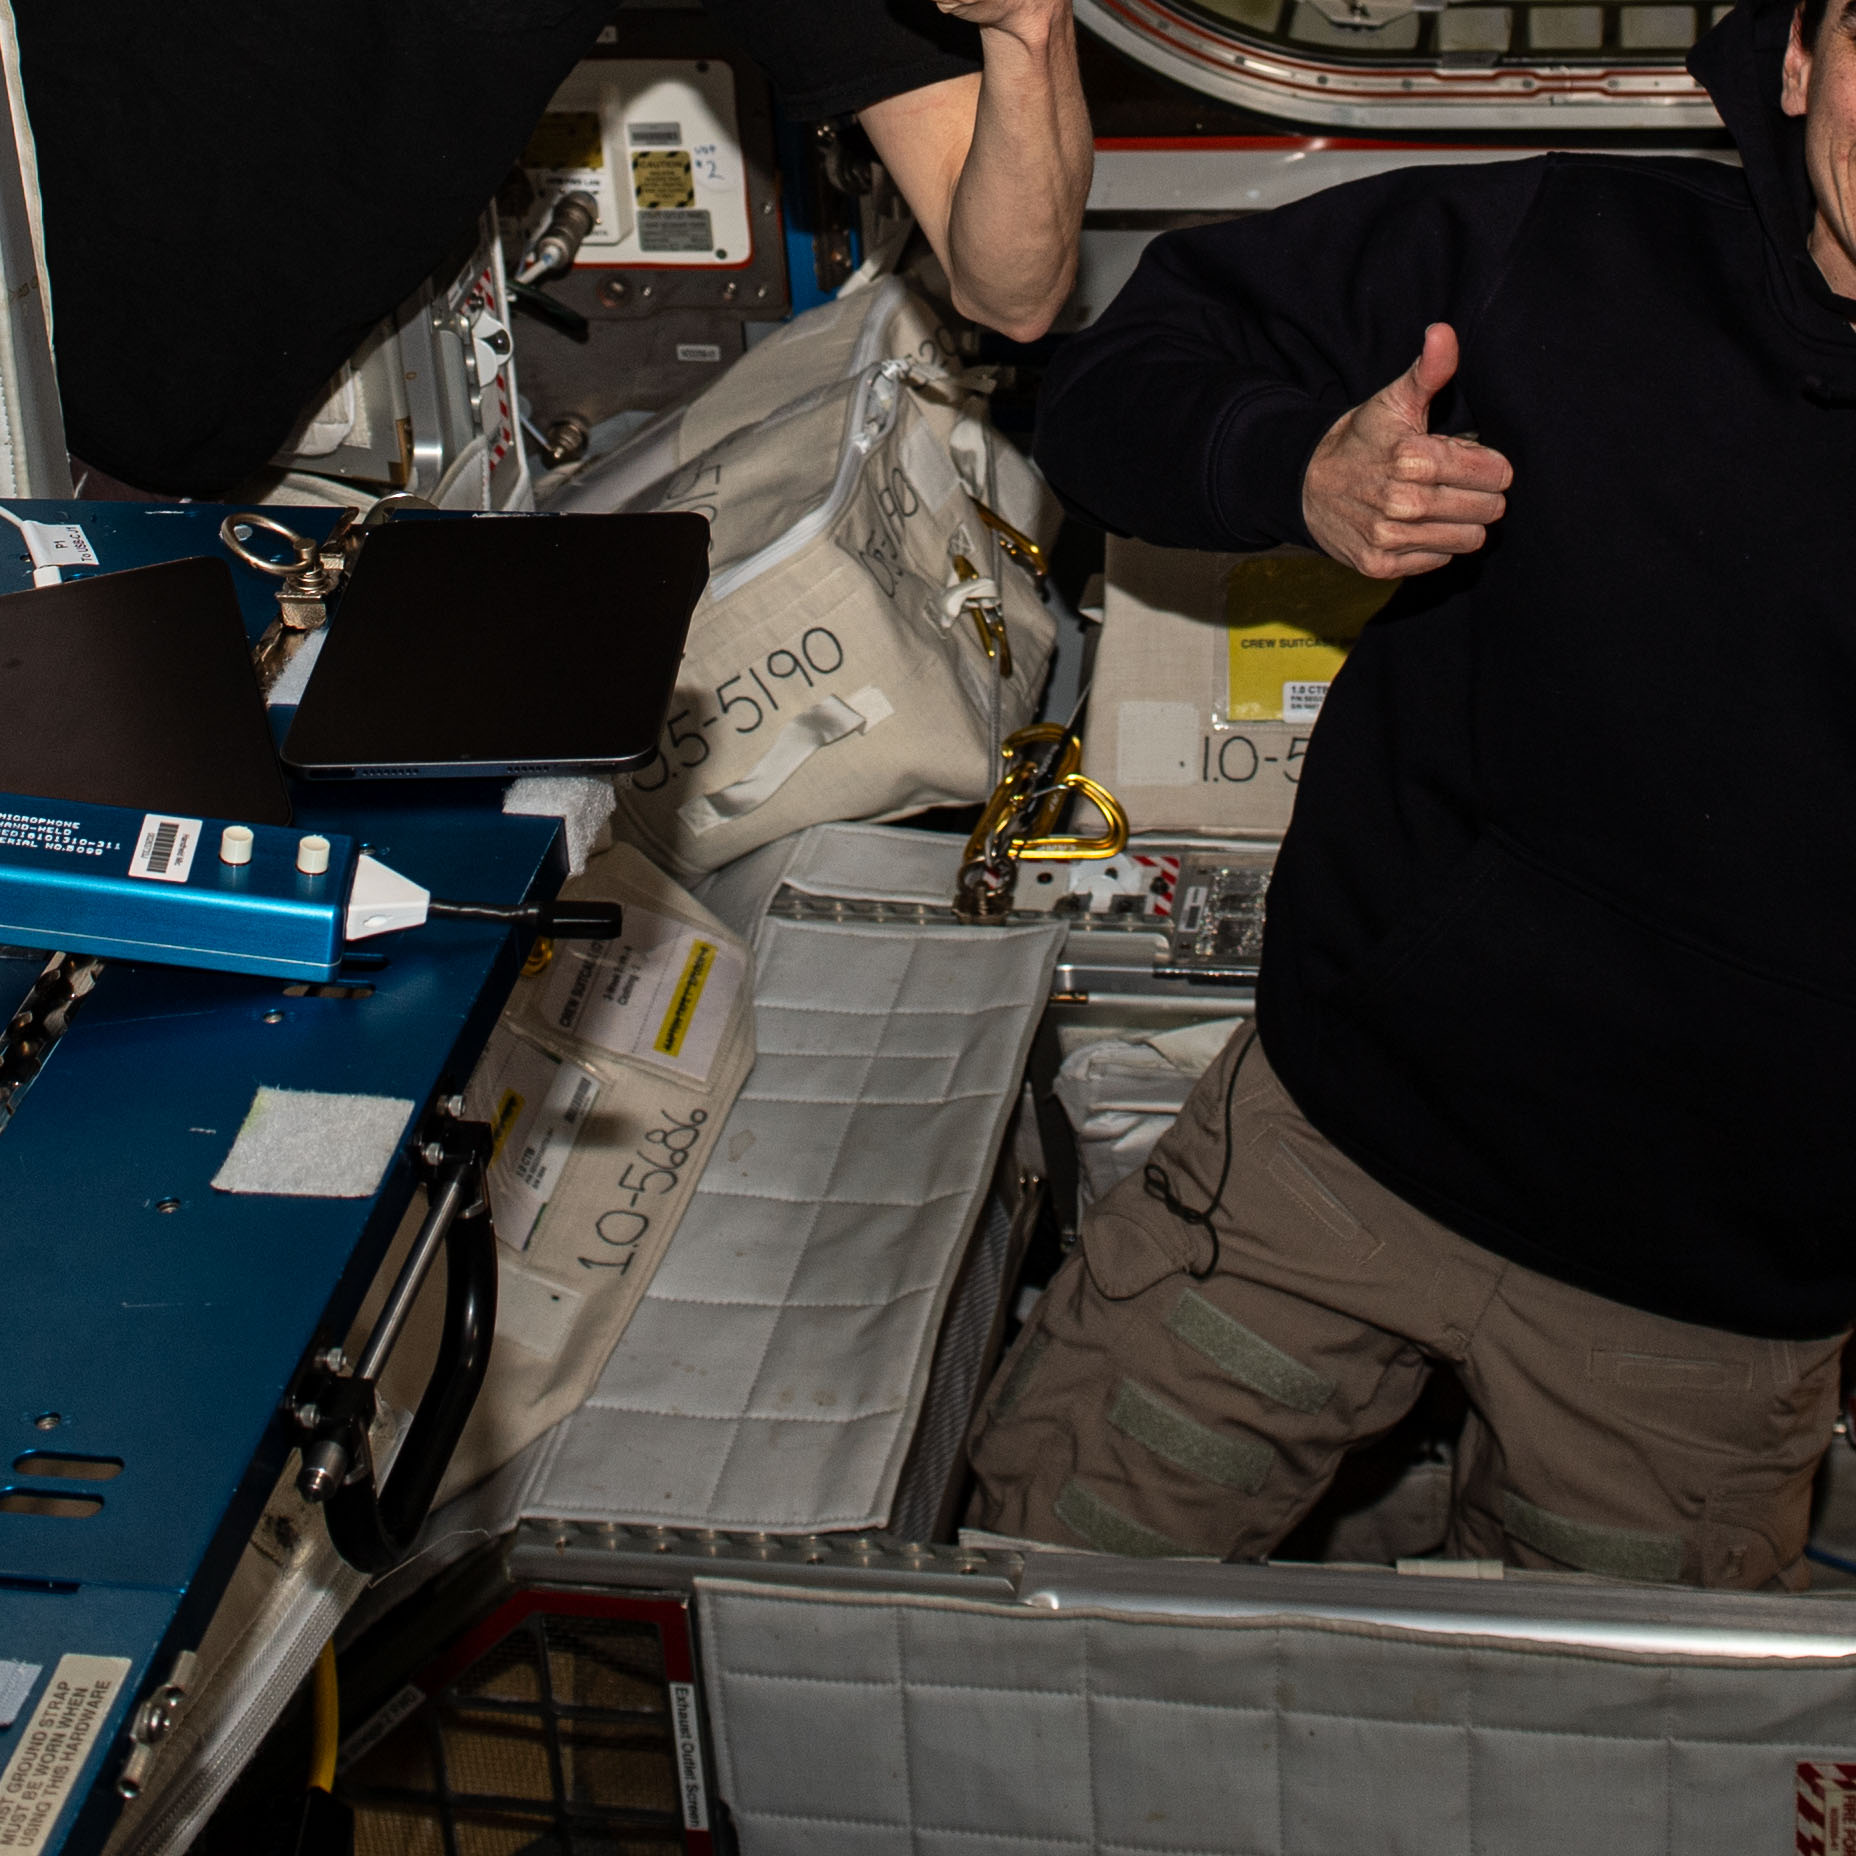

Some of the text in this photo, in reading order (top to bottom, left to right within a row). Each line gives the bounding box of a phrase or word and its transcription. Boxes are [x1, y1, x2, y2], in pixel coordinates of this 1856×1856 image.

[54, 539, 69, 550] P1
[1241, 638, 1276, 650] CREW
[0, 1687, 90, 1847] MUST BE WORN WHEN
[6, 1729, 48, 1795] GROUND
[38, 1680, 70, 1728] STRAP
[16, 1680, 112, 1848] USING THIS HARDWARE
[673, 1686, 701, 1828] Exhaust Outlet Screen
